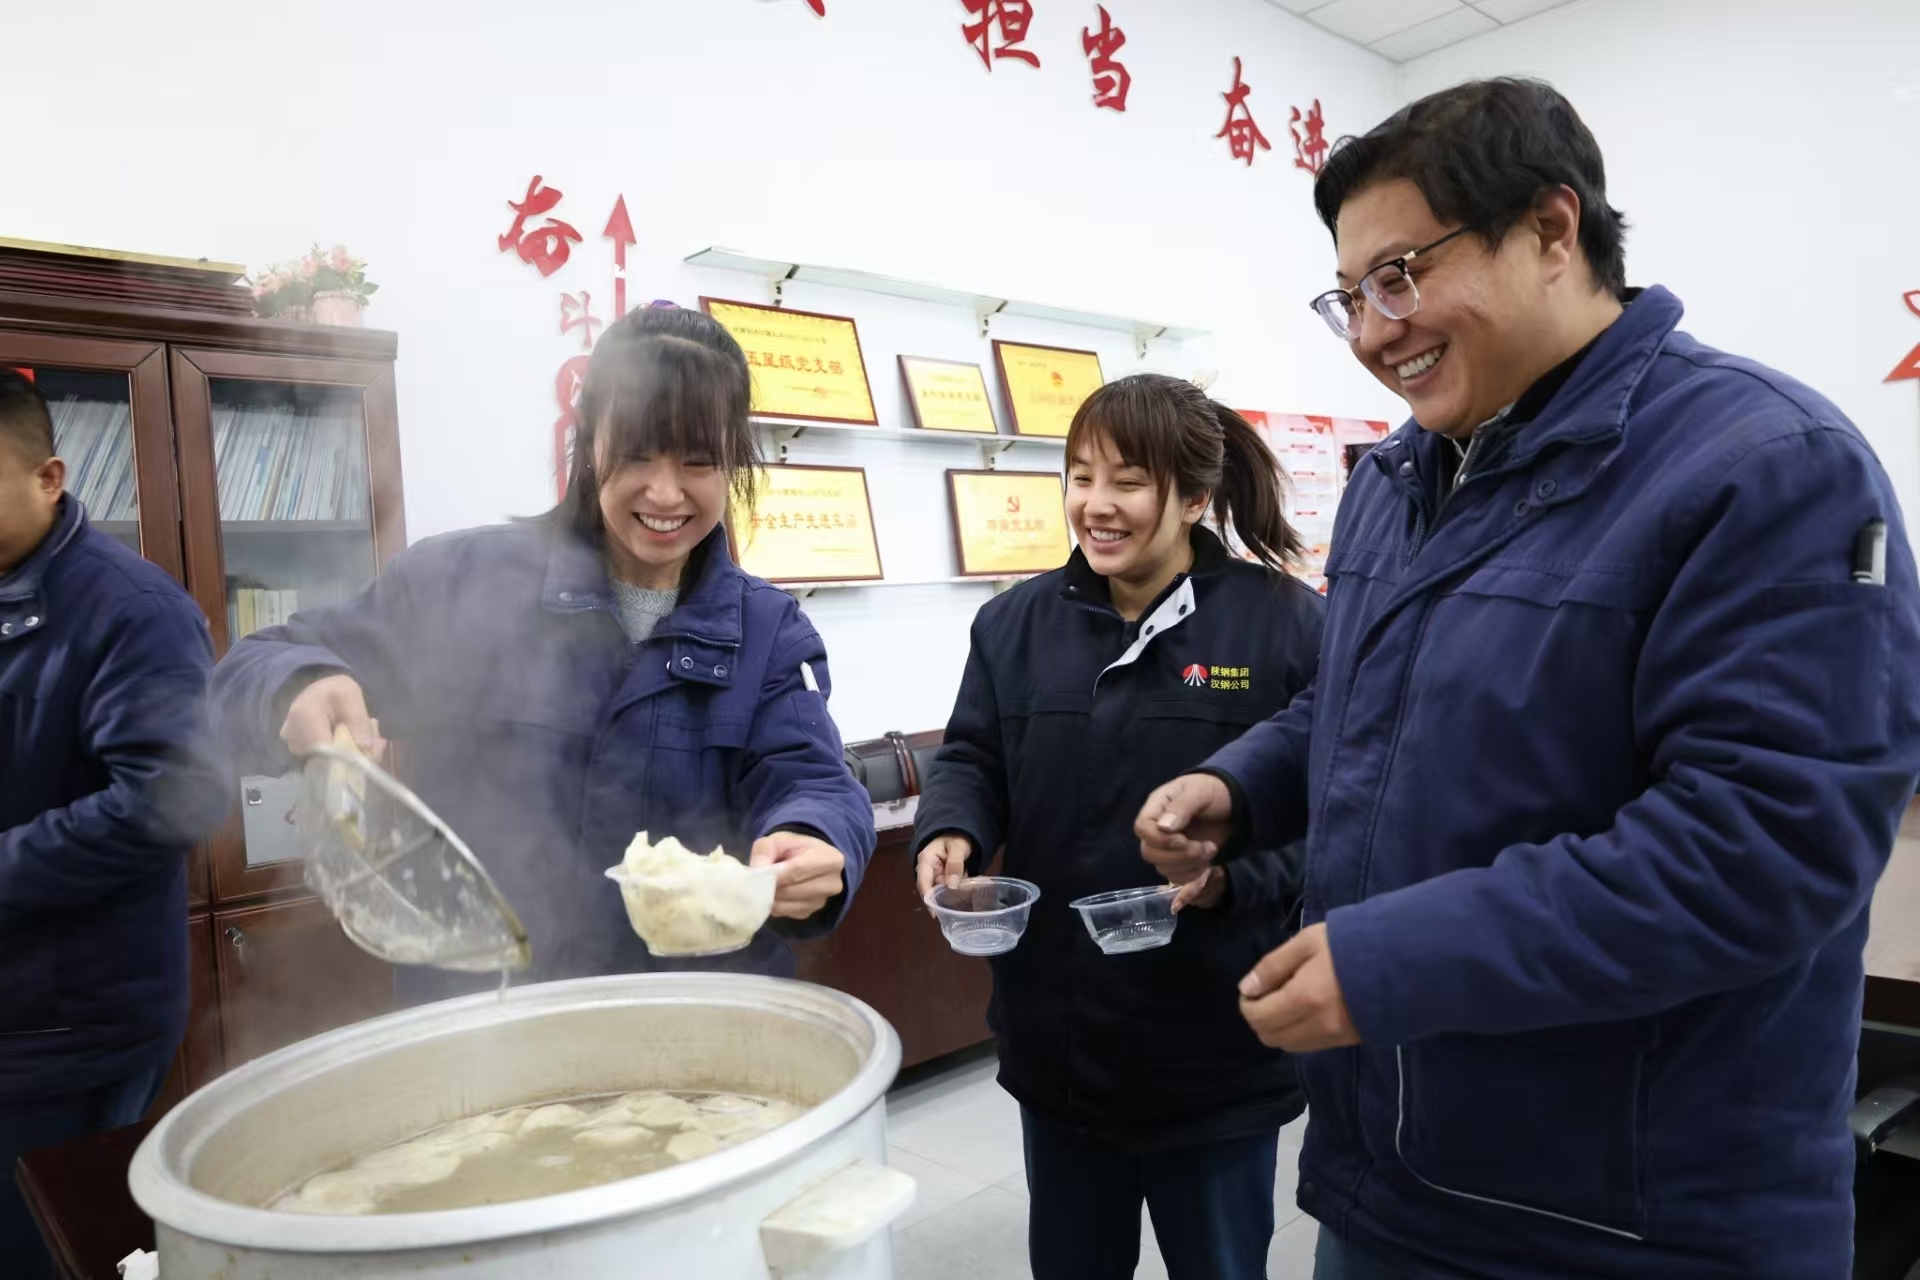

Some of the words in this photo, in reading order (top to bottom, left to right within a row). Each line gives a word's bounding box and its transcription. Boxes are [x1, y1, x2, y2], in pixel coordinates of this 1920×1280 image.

[1210, 665, 1250, 678] 陕钢集团
[1210, 678, 1250, 691] 汉钢公司
